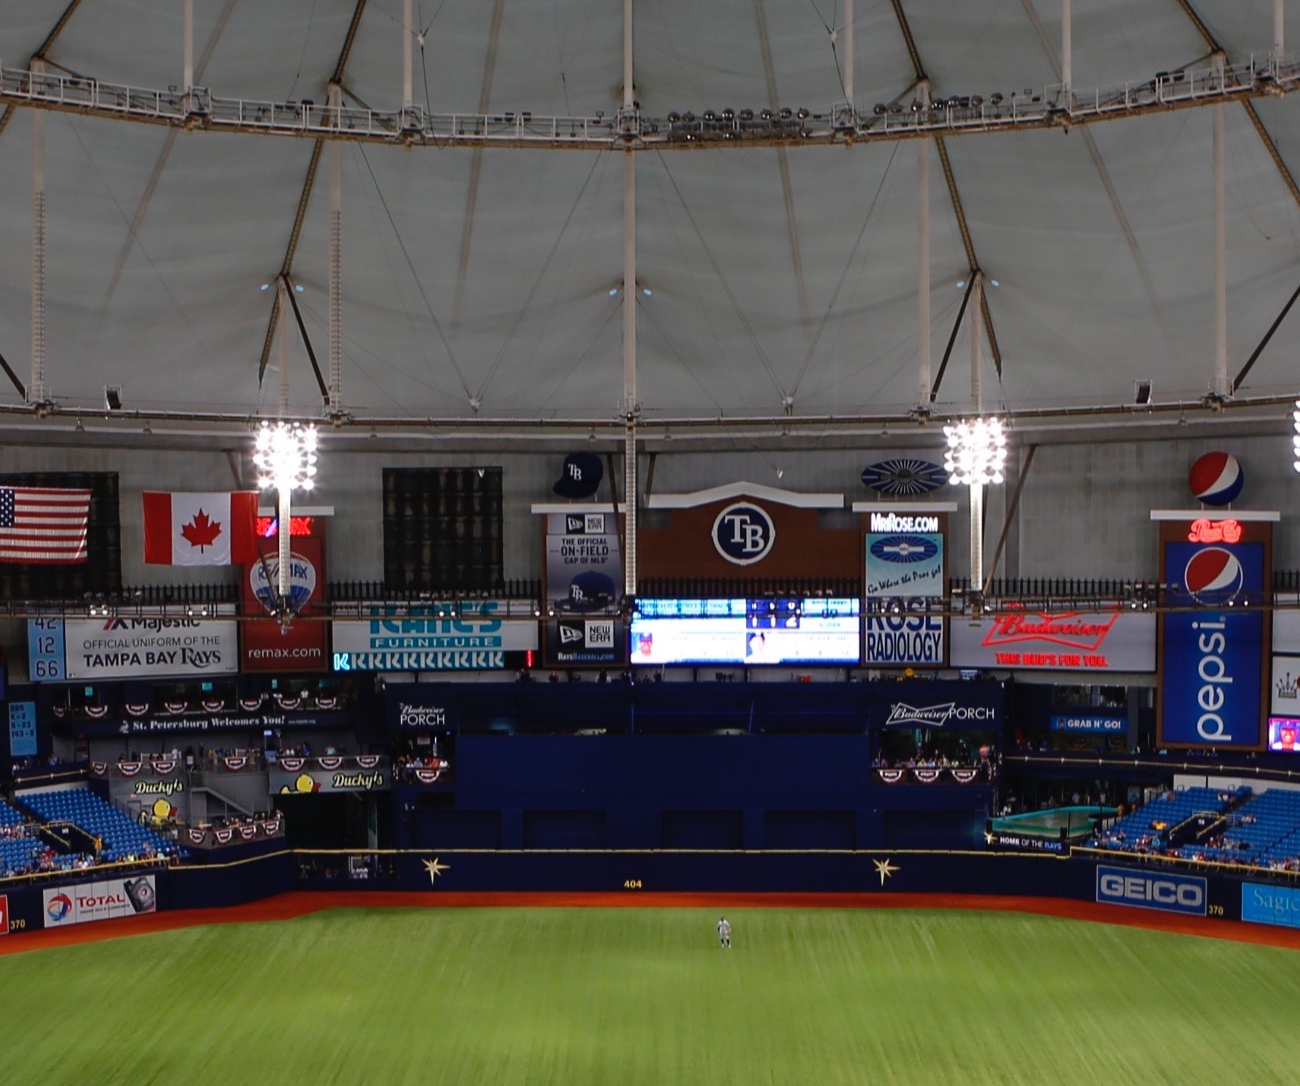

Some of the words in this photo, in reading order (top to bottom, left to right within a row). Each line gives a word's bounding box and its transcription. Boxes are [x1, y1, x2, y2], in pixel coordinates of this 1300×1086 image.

[568, 463, 582, 481] TB
[724, 515, 764, 553] TB
[579, 538, 607, 546] OFFICIAL
[561, 545, 609, 556] ON-FIELD
[589, 625, 611, 633] NEW
[37, 636, 55, 653] 12
[83, 639, 130, 649] OFFICIAL
[132, 638, 181, 648] UNIFORM
[183, 637, 198, 646] OF
[200, 636, 220, 645] THE
[375, 637, 495, 648] FURNITURE
[867, 632, 941, 663] RADIOLOGY
[84, 653, 141, 667] TAMPA
[146, 652, 177, 665] BAY
[180, 648, 221, 668] RAYS
[248, 647, 321, 658] remax.com
[36, 660, 59, 677] 66
[1192, 621, 1233, 742] pepsi
[400, 714, 446, 726] PORCH
[949, 707, 995, 720] PORCH
[132, 720, 147, 731] St.
[149, 718, 208, 731] Petersburg
[211, 716, 261, 728] Welcomes
[262, 715, 286, 727] You!
[1067, 719, 1091, 729] GRAB
[1104, 720, 1122, 730] GO!
[134, 778, 185, 796] Ducky's
[331, 771, 385, 789] Ducky's
[1000, 836, 1020, 846] HOME
[1020, 837, 1030, 847] OF
[1031, 839, 1043, 848] THE
[1044, 841, 1062, 850] RAYS
[623, 879, 643, 889] 404
[1099, 874, 1203, 907] GEICO
[75, 893, 126, 909] TOTAL
[1208, 904, 1224, 917] 370
[10, 918, 26, 930] 370
